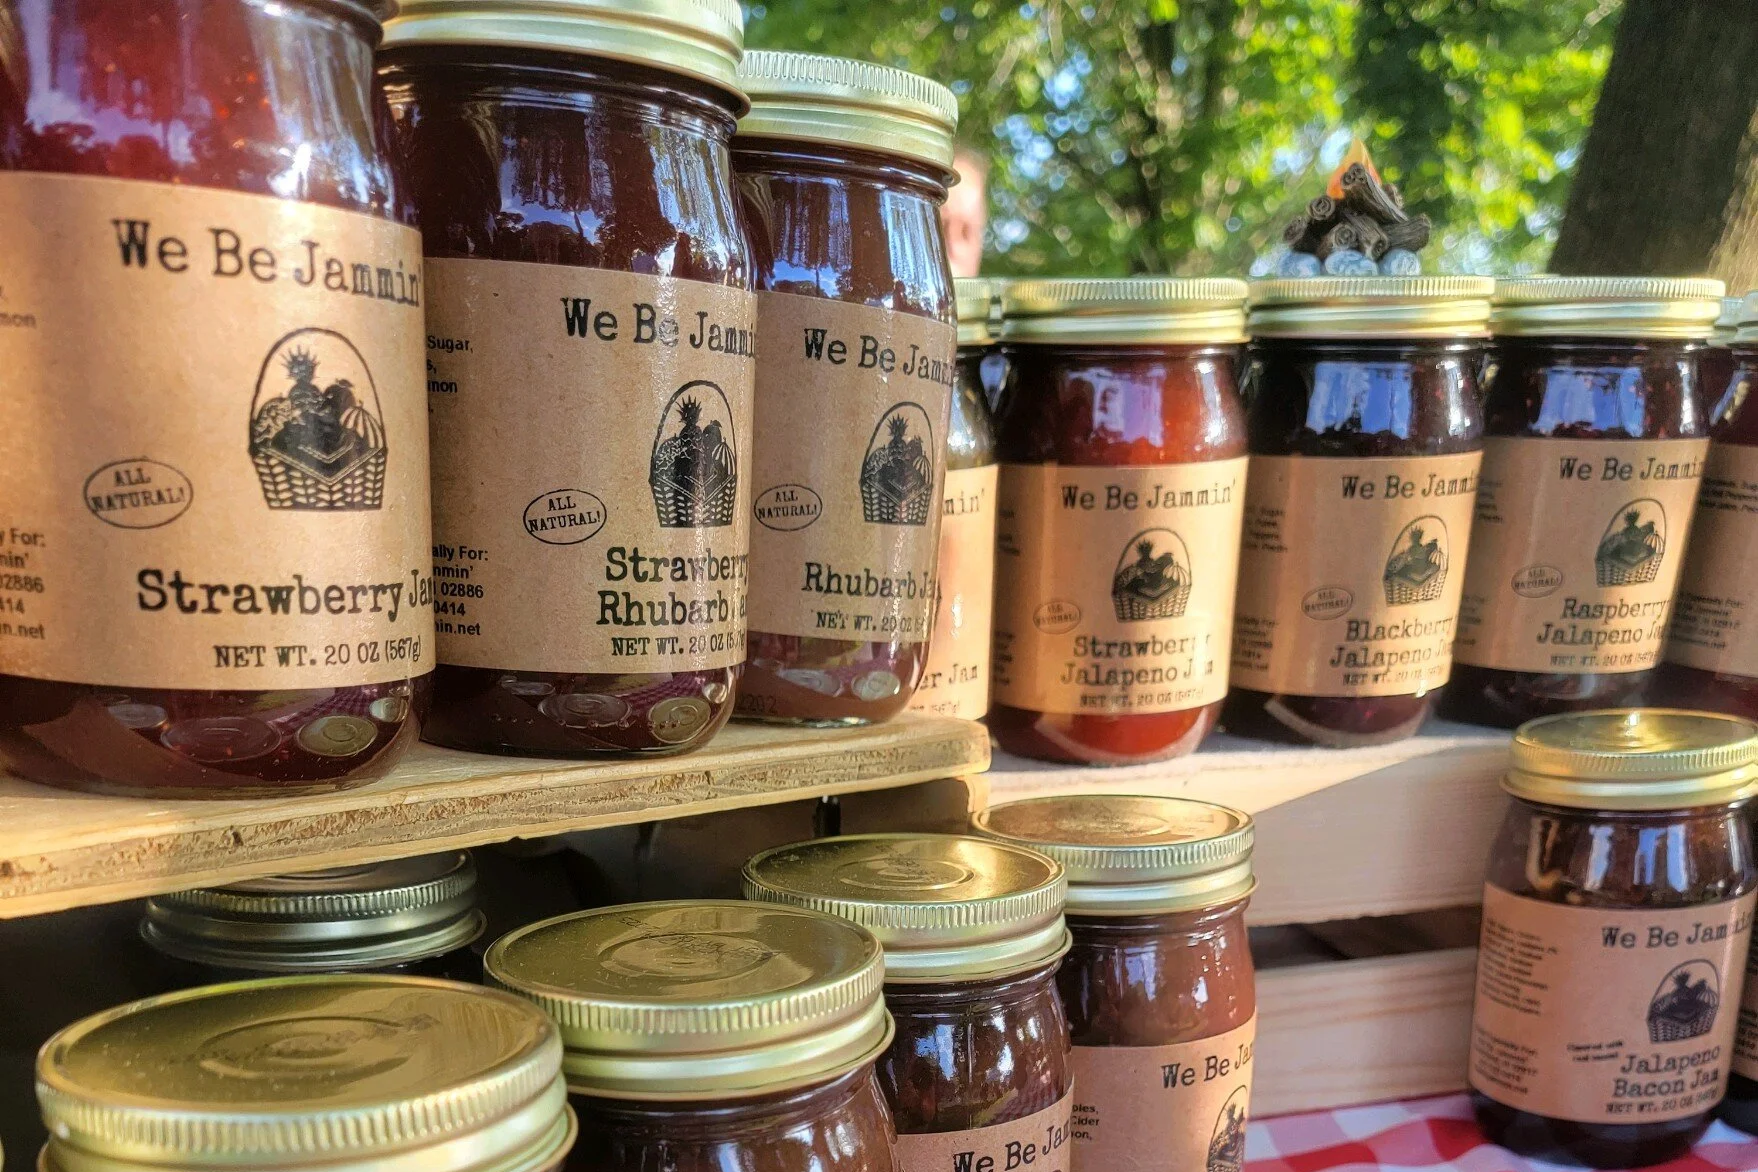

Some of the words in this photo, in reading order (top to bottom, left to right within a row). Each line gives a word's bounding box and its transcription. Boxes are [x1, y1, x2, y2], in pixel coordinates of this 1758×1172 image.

[111, 219, 188, 274] We
[209, 228, 276, 282] Be
[294, 241, 421, 308] Jammin'
[560, 297, 618, 342] We
[633, 303, 680, 347] Be
[427, 335, 474, 354] Sugar,
[804, 328, 847, 364] We
[858, 335, 896, 373] Be
[114, 468, 151, 487] ALL
[1559, 457, 1592, 481] We
[1600, 457, 1633, 481] Be
[774, 490, 799, 502] ALL
[1062, 486, 1095, 510] We
[1105, 486, 1138, 510] Be
[1146, 479, 1236, 509] Jammin'
[1341, 475, 1375, 499] We
[1384, 474, 1416, 499] Be
[91, 487, 186, 514] NATURAL!
[548, 497, 576, 511] ALL
[757, 505, 819, 519] NATURAL!
[527, 511, 601, 533] NATURAL!
[10, 528, 46, 548] For:
[459, 546, 489, 561] For:
[441, 582, 484, 598] 02886
[802, 562, 917, 600] Rhubarb
[137, 568, 403, 622] Strawberry
[596, 590, 728, 627] Rhubarb
[816, 611, 849, 629] NET
[853, 614, 877, 631] WT.
[1560, 598, 1669, 623] Raspberry
[611, 637, 650, 656] NET
[654, 637, 684, 655] WT.
[688, 636, 706, 655] 20
[710, 633, 724, 652] OZ
[1537, 622, 1642, 649] Jalapeno
[213, 645, 266, 669] NET
[274, 645, 316, 667] WT.
[324, 643, 351, 665] 20
[356, 641, 380, 664] OZ
[385, 636, 422, 664] (567g)
[1329, 645, 1432, 673] Jalapeno
[1061, 660, 1178, 692] Jalapeno
[1602, 926, 1636, 948] We
[1646, 926, 1679, 949] Be
[1161, 1062, 1196, 1089] We
[1203, 1055, 1230, 1081] Be
[1620, 1045, 1720, 1076] Jalapeno
[1613, 1077, 1685, 1099] Bacon
[1004, 1141, 1036, 1172] Be
